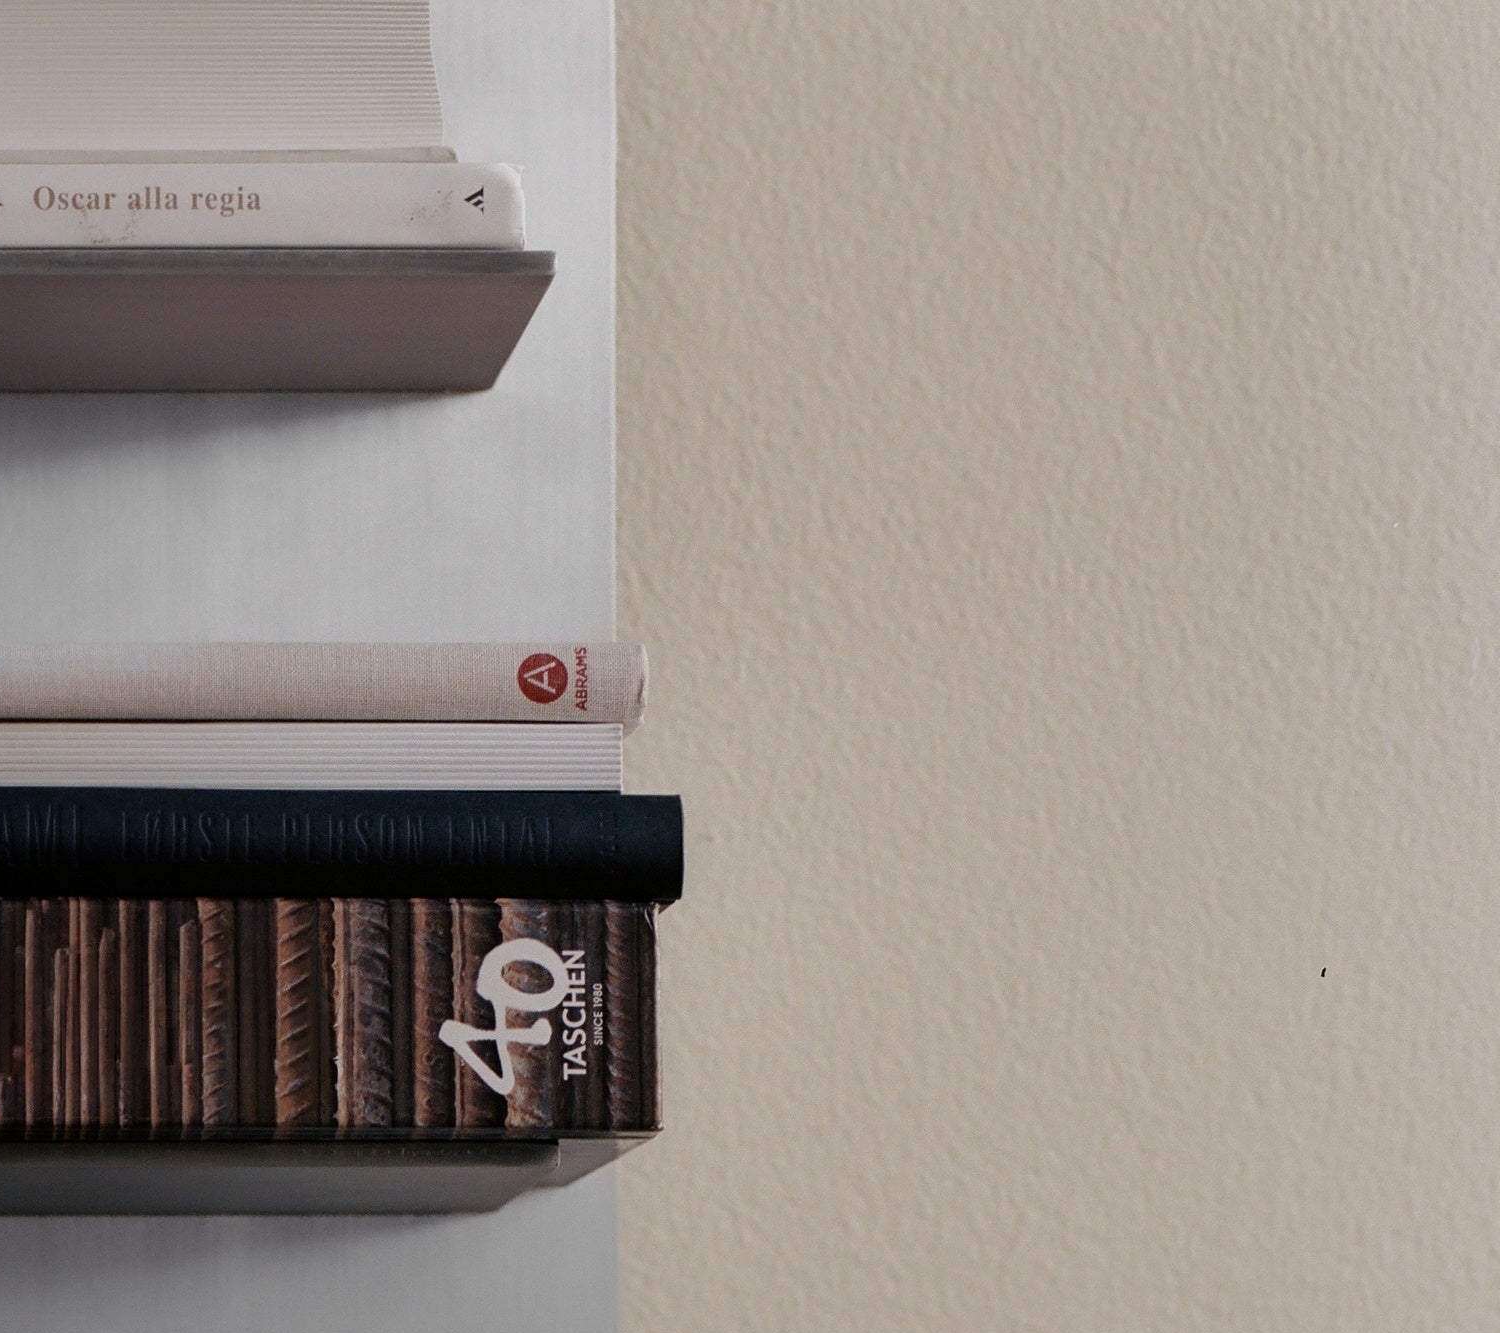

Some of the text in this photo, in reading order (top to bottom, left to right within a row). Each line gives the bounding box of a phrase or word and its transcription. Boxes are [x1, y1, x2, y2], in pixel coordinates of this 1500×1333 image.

[33, 186, 261, 217] Oscar alla regia
[575, 647, 588, 711] ABRAMS
[281, 812, 425, 866] PERSON
[438, 937, 568, 1095] 40
[562, 950, 587, 1081] TASCHEN
[592, 983, 604, 1046] SINCE 1980
